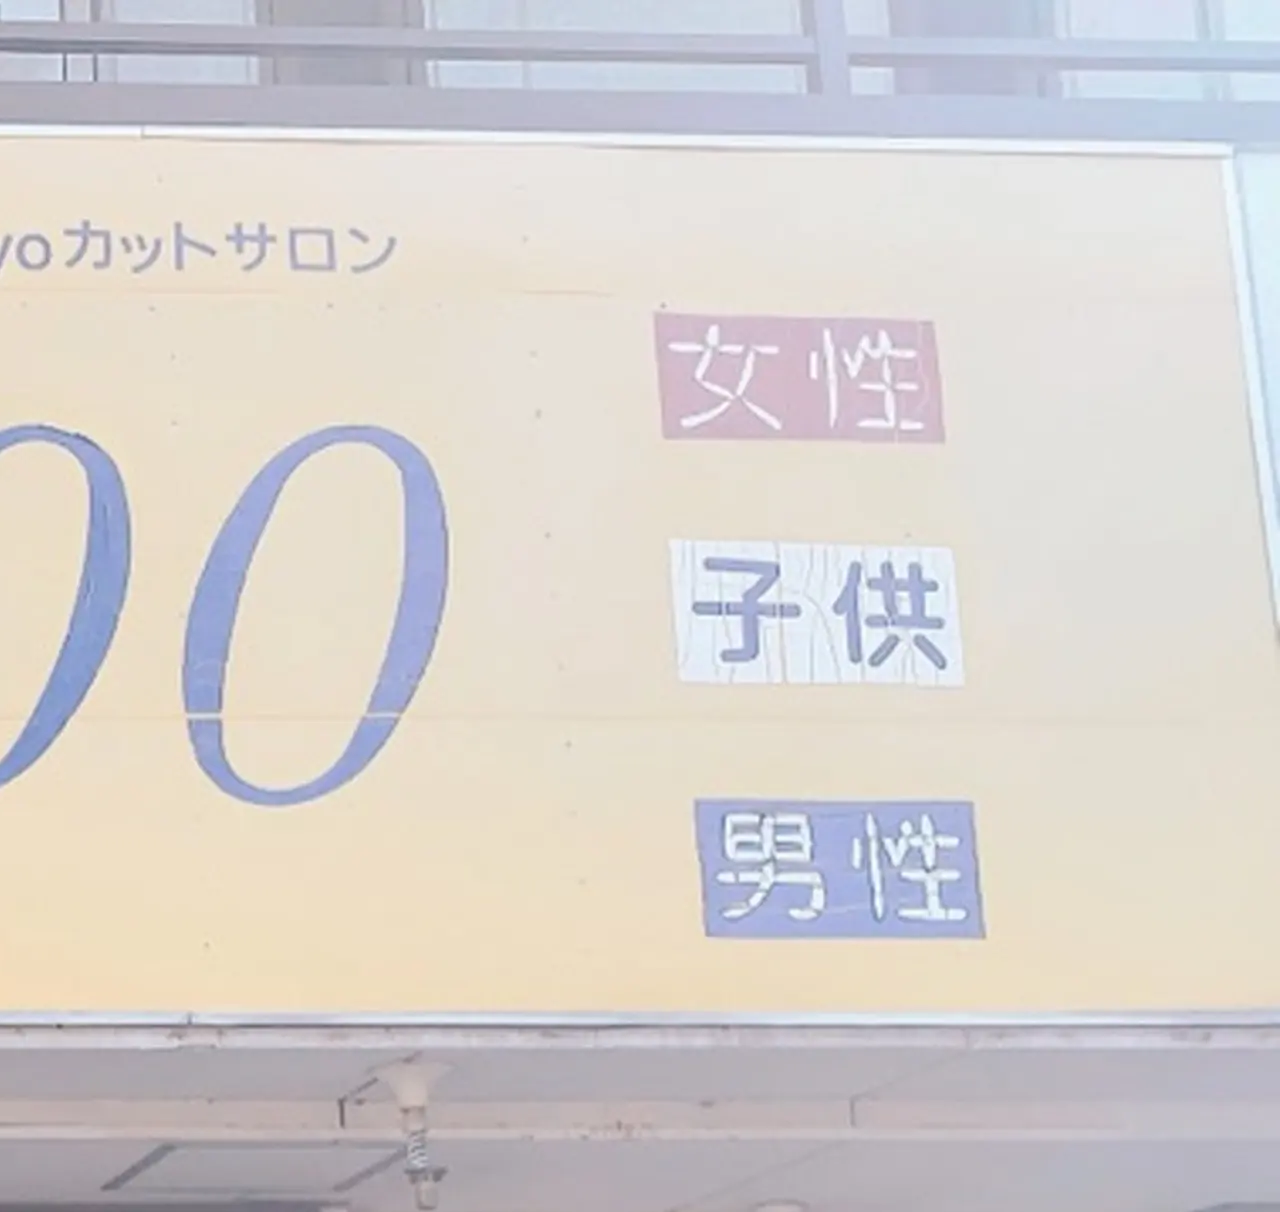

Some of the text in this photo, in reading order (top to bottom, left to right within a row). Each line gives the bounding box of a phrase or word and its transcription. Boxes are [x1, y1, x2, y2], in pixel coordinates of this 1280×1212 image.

[667, 323, 926, 430] 女性
[692, 557, 948, 671] 子供
[717, 813, 967, 922] 男性
